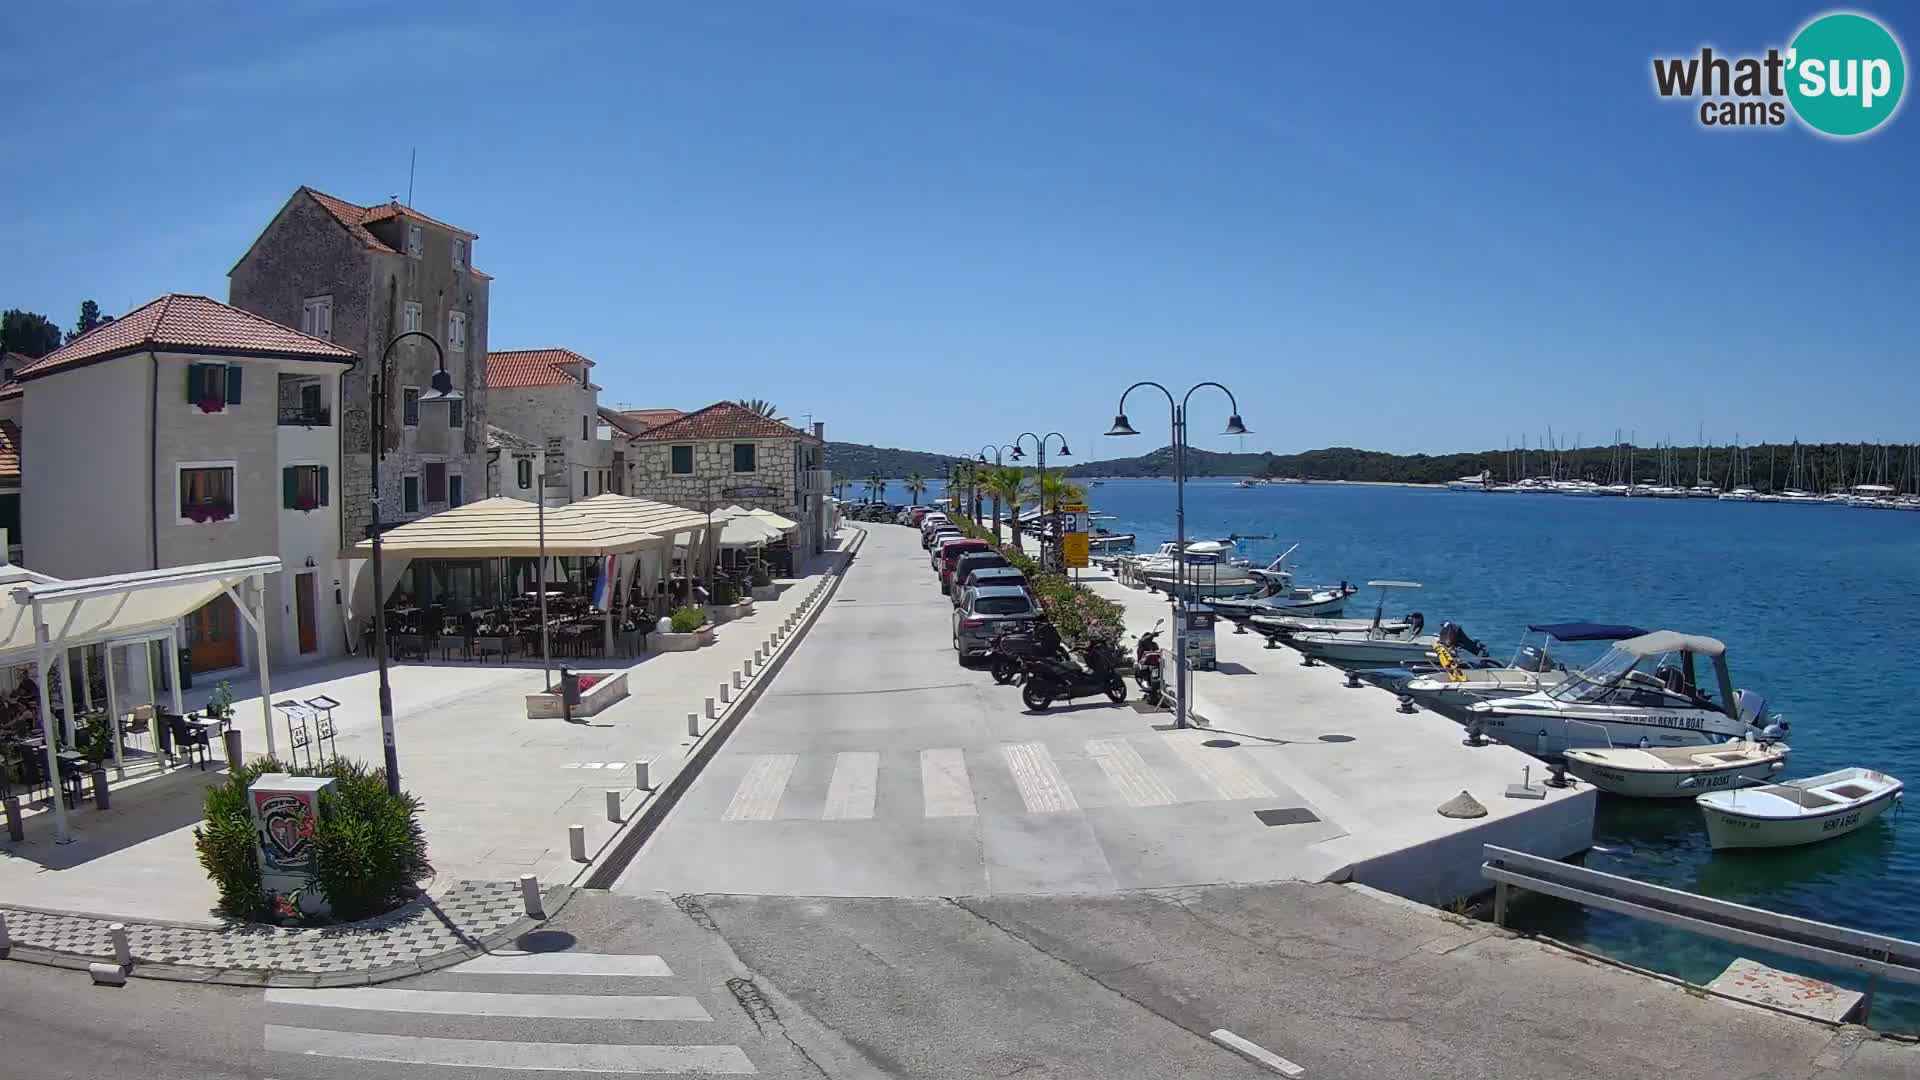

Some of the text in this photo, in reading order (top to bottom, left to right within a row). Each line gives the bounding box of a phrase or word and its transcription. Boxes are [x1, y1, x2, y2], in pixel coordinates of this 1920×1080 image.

[1658, 716, 1679, 728] RENT
[1679, 716, 1685, 728] A
[1686, 717, 1705, 729] BOAT
[1713, 774, 1731, 787] BOAT
[1822, 817, 1840, 832] RENT
[1845, 812, 1861, 827] BOAT
